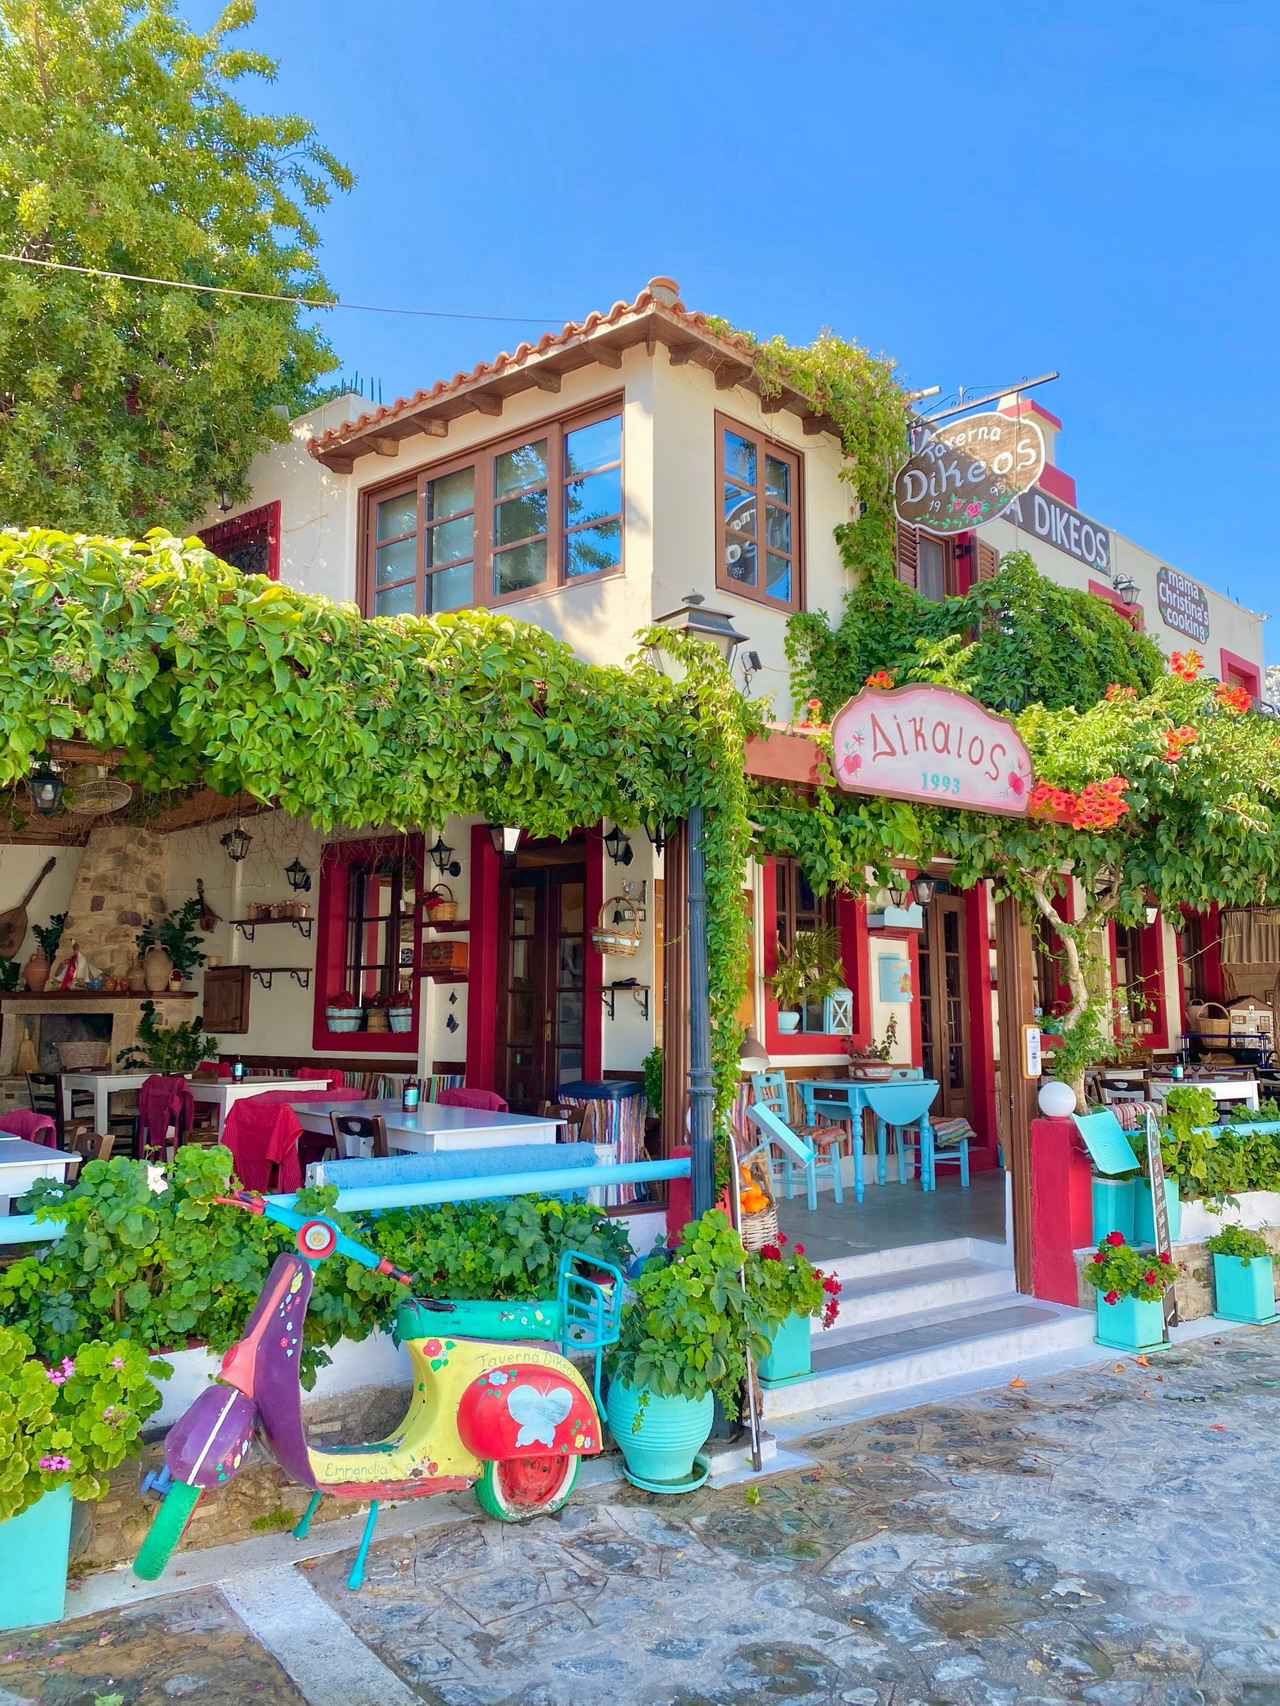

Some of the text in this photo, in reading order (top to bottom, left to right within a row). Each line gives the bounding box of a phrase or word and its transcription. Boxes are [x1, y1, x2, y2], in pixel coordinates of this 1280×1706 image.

[929, 482, 1006, 512] 19 93
[1034, 494, 1107, 568] DIKEOS
[1168, 569, 1199, 596] mama
[1158, 582, 1209, 626] Christina's
[1166, 607, 1206, 644] cooking
[921, 772, 961, 795] 1993
[475, 1351, 577, 1380] Taverna Dikeos
